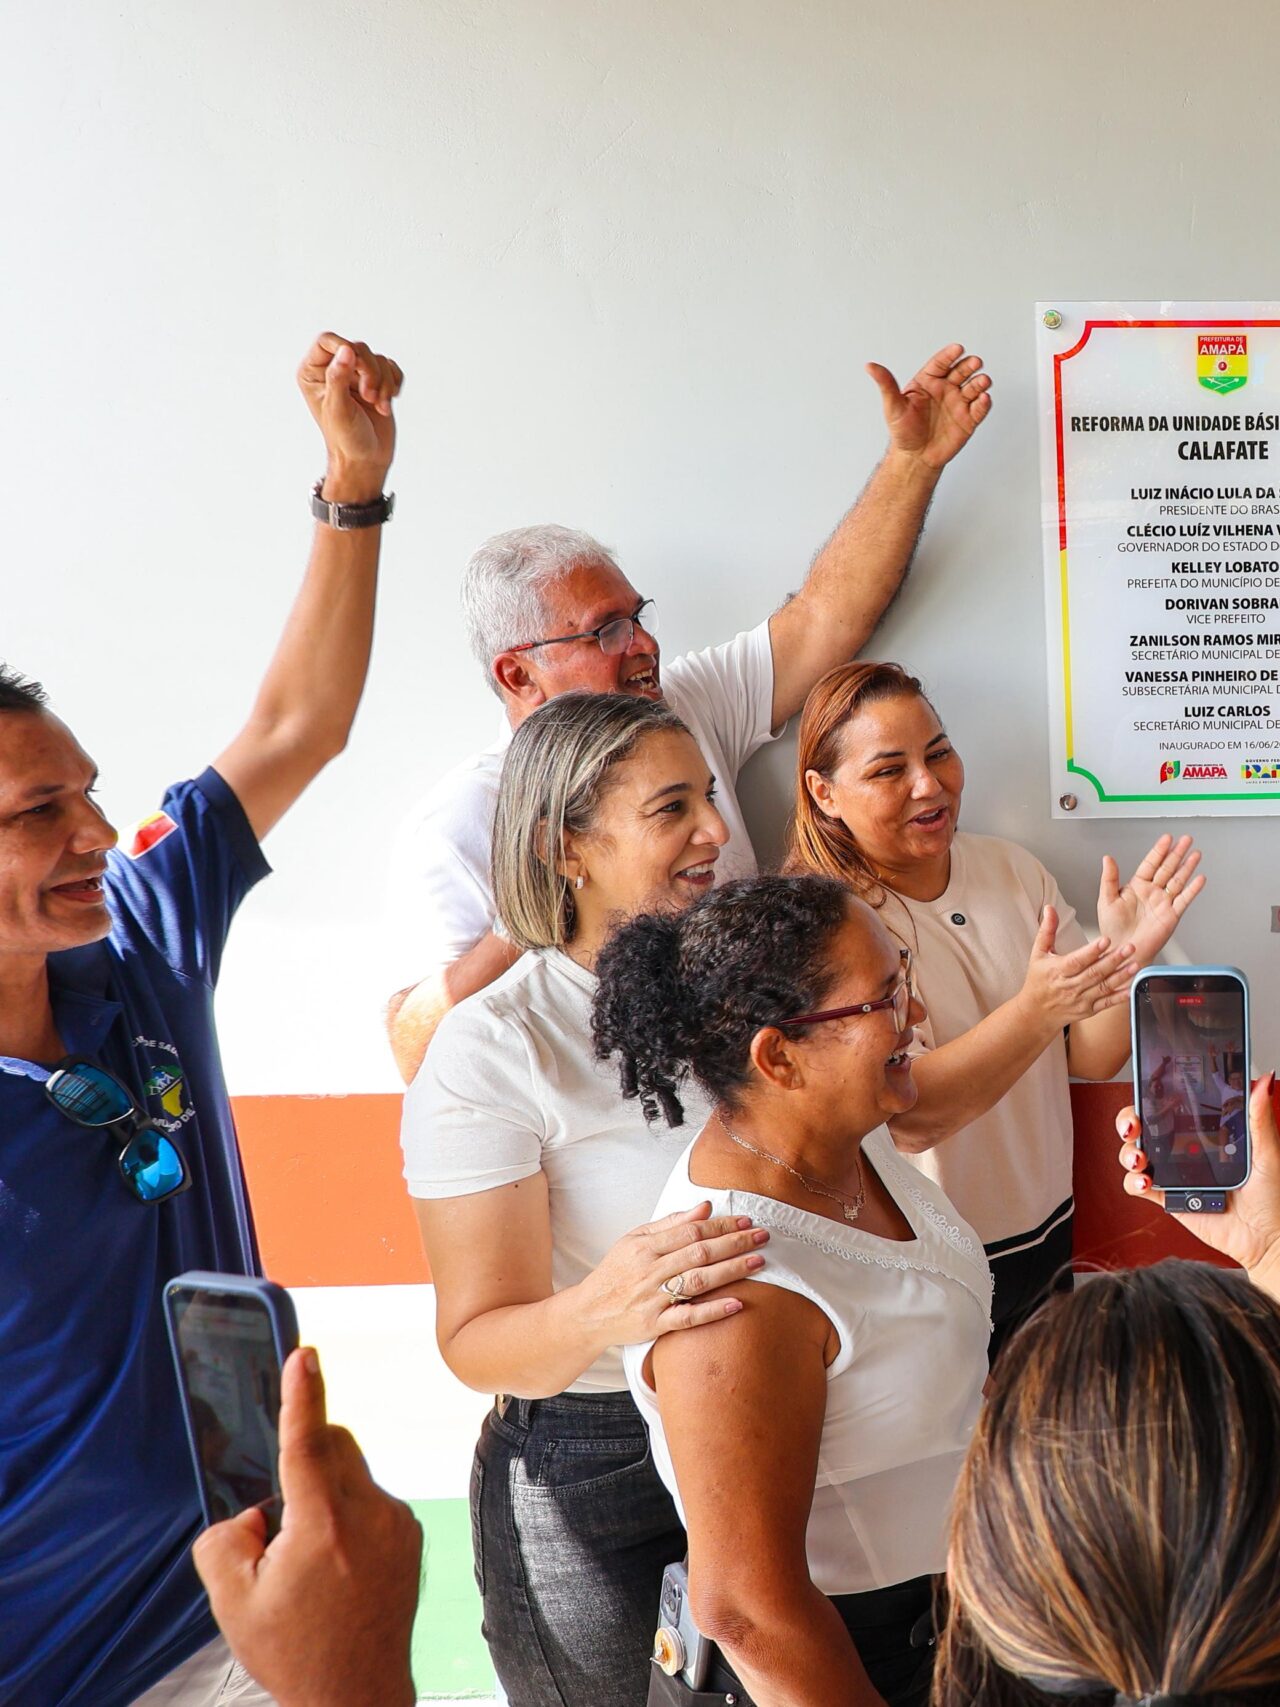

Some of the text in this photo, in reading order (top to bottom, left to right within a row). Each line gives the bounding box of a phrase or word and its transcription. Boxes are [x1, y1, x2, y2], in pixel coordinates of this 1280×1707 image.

[1200, 342, 1245, 355] AMAPÁ
[1071, 416, 1145, 432] REFORMA
[1148, 416, 1169, 432] DA
[1172, 415, 1241, 432] UNIDADE
[1178, 440, 1269, 460] CALAFATE
[1131, 488, 1162, 500] LUIZ
[1165, 485, 1214, 500] INÁCIO
[1217, 487, 1252, 499] LULA
[1256, 487, 1276, 499] DA
[1160, 505, 1227, 516] PRESIDENTE
[1230, 505, 1248, 515] DO
[1127, 523, 1176, 537] CLÉCIO
[1179, 522, 1210, 537] LUÍZ
[1212, 524, 1274, 536] VILHENA
[1117, 542, 1199, 552] GOVERNADOR
[1202, 542, 1220, 552] DO
[1223, 541, 1268, 552] ESTADO
[1172, 561, 1280, 574] KELLEY LOBATO
[1127, 578, 1178, 589] PREFEITA
[1180, 578, 1199, 588] DO
[1201, 576, 1262, 588] MUNICÍPIO
[1265, 577, 1280, 588] DE
[1165, 598, 1229, 610] DORIVAN
[1186, 613, 1266, 624] VICE PREFEITO
[1130, 635, 1200, 647] ZANILSON
[1204, 634, 1254, 646] RAMOS
[1131, 648, 1199, 661] SECRETÁRIO
[1201, 649, 1263, 660] MUNICIPAL
[1265, 649, 1280, 659] DE
[1125, 671, 1188, 683] VANESSA
[1192, 670, 1257, 682] PINHEIRO
[1260, 670, 1278, 681] DE
[1122, 684, 1210, 696] SUBSECRETÁRIA
[1212, 684, 1274, 695] MUNICIPAL
[1184, 705, 1271, 718] LUIZ CARLOS
[1133, 719, 1200, 731] SECRETÁRIO
[1202, 720, 1264, 730] MUNICIPAL
[1266, 719, 1280, 730] DE
[1159, 741, 1226, 750] INAUGURADO
[1227, 741, 1242, 750] EM
